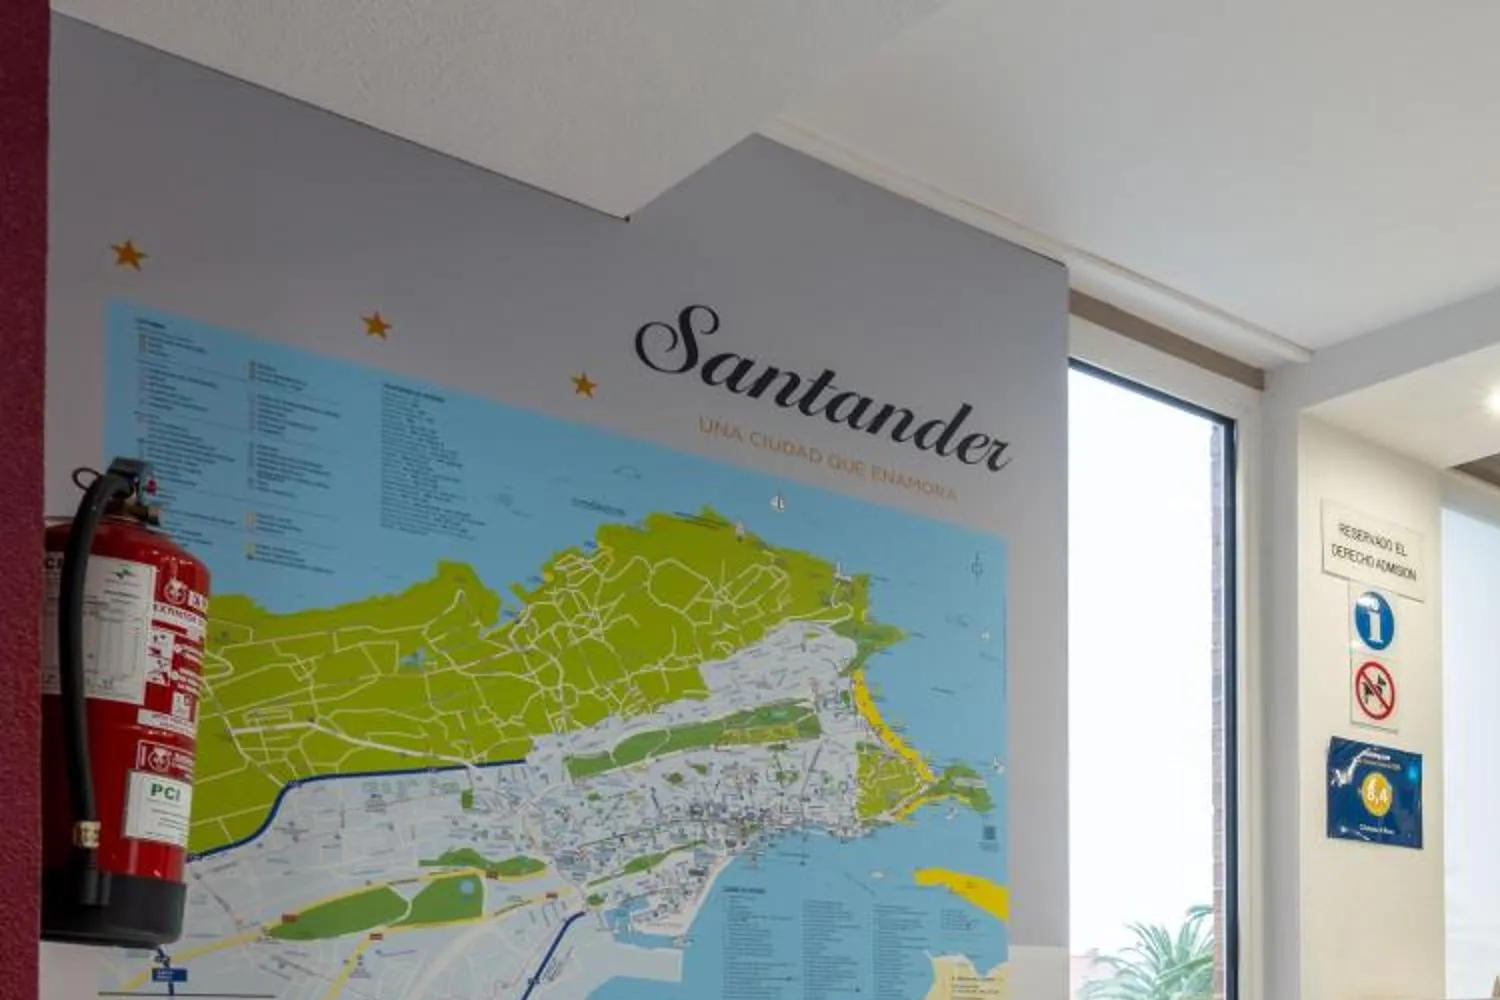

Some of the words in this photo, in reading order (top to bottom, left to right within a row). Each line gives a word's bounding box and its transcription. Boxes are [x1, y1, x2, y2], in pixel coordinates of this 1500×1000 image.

[634, 303, 1013, 473] Santander
[698, 416, 744, 446] UNA
[750, 431, 823, 465] CIUDAD
[827, 454, 868, 478] QUE
[871, 465, 960, 503] ENAMORA
[1331, 543, 1375, 569] DERECHO
[1338, 523, 1393, 553] RESERVADO
[1395, 541, 1408, 557] EL
[150, 783, 181, 802] PCI
